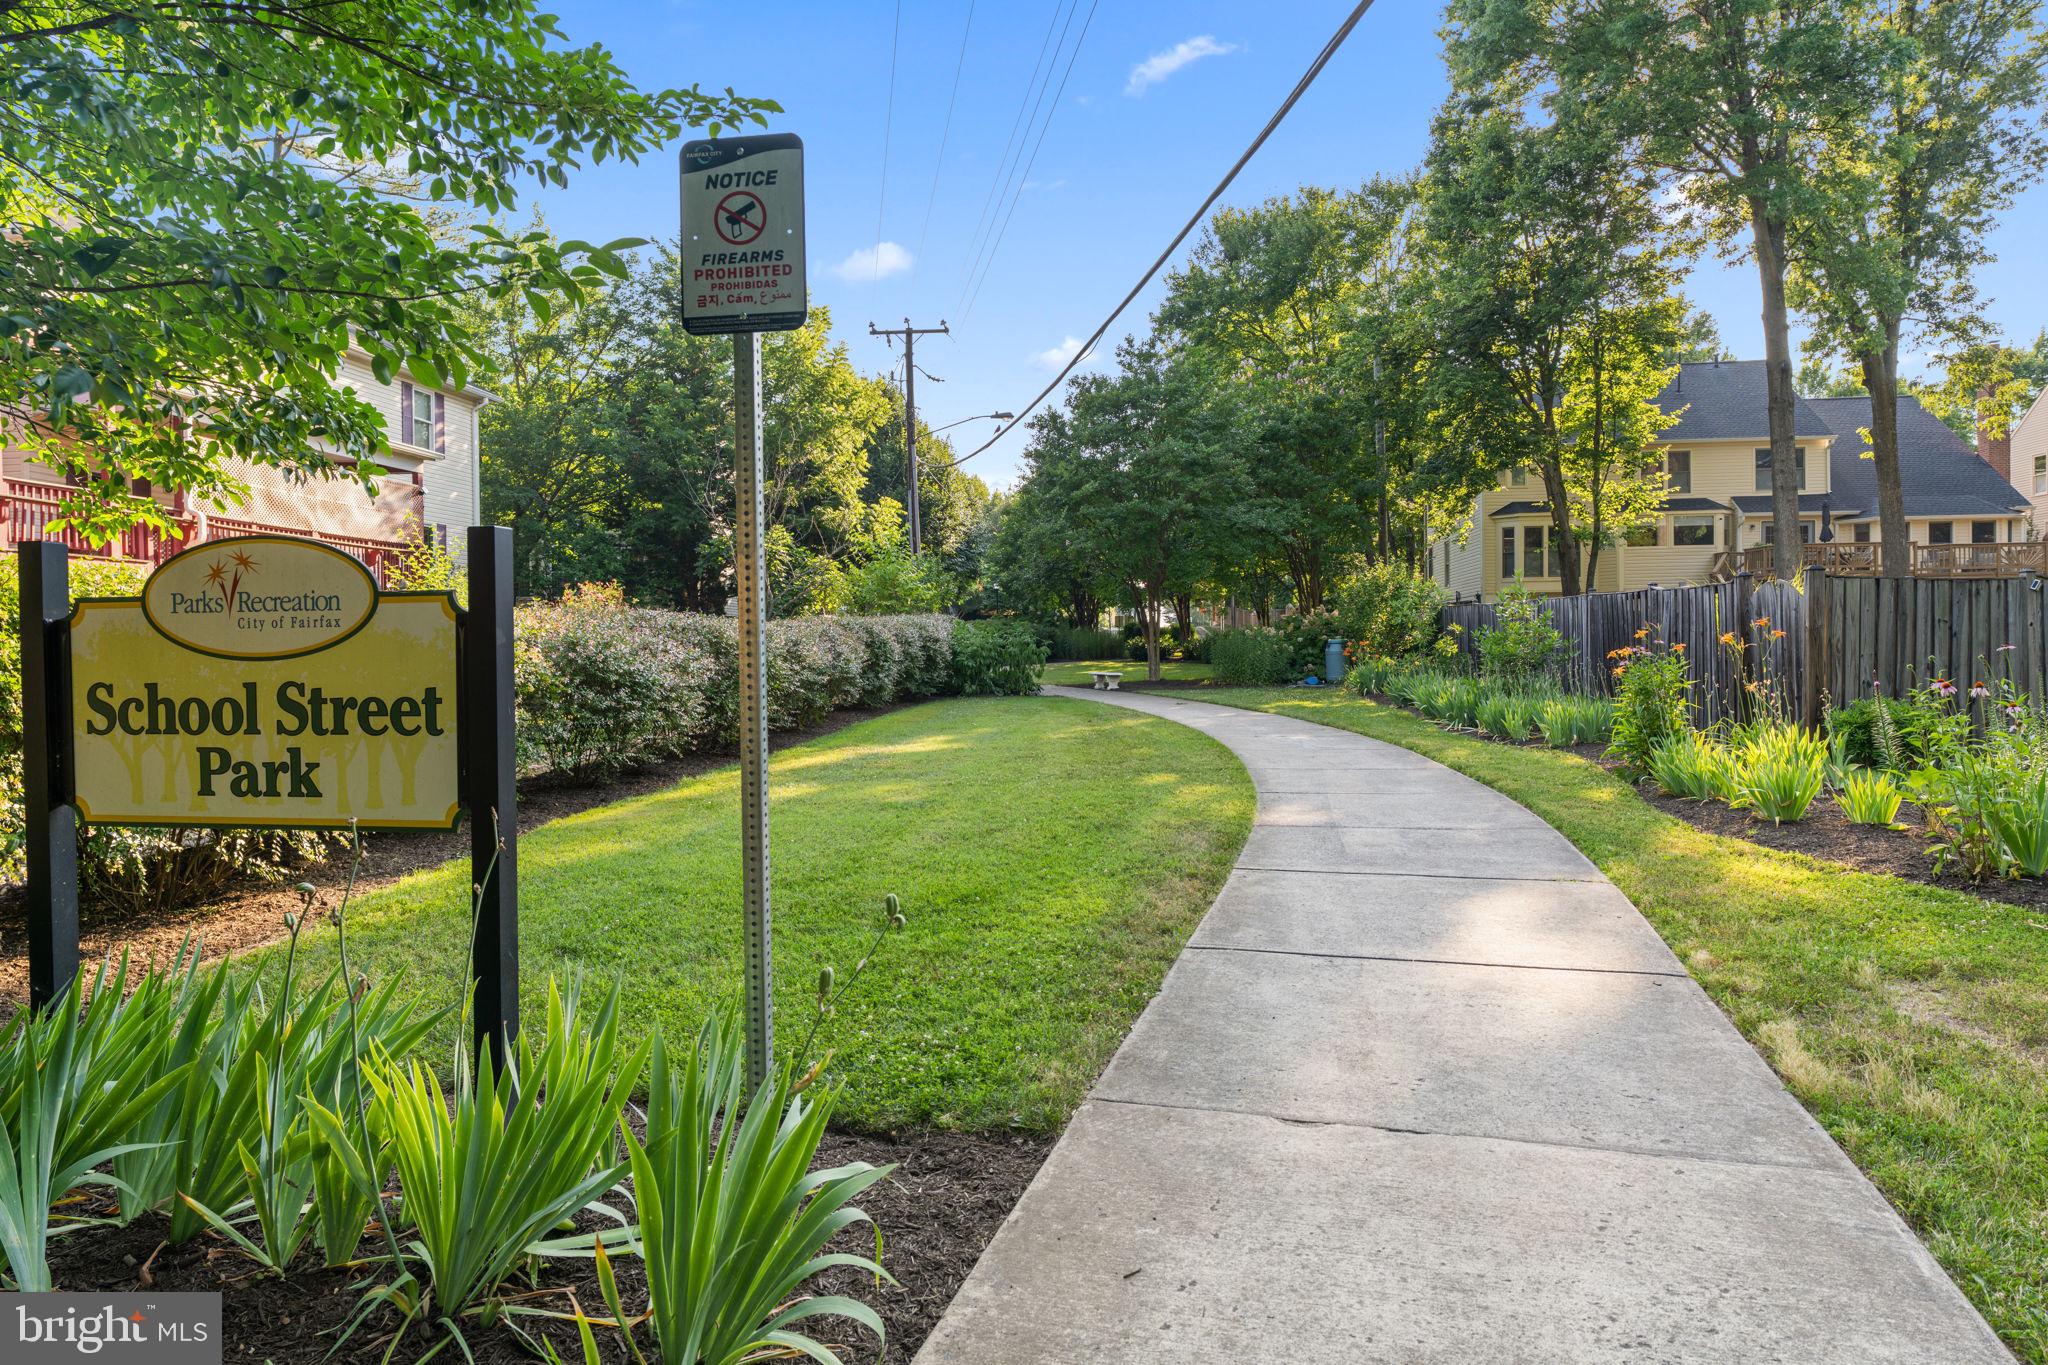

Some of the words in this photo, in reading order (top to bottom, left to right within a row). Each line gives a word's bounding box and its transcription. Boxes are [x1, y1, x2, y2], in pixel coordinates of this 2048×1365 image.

[705, 169, 778, 190] NOTICE
[701, 250, 784, 266] FIREARMS
[694, 264, 792, 281] PROHIBITED
[711, 280, 778, 291] PROHIBIDAS
[170, 591, 224, 614] Parks
[237, 590, 341, 612] Recreation
[237, 617, 265, 631] City
[271, 616, 285, 628] of
[290, 615, 341, 628] Fairfax
[86, 682, 261, 736] School
[276, 681, 444, 736] Street
[197, 747, 322, 798] Park
